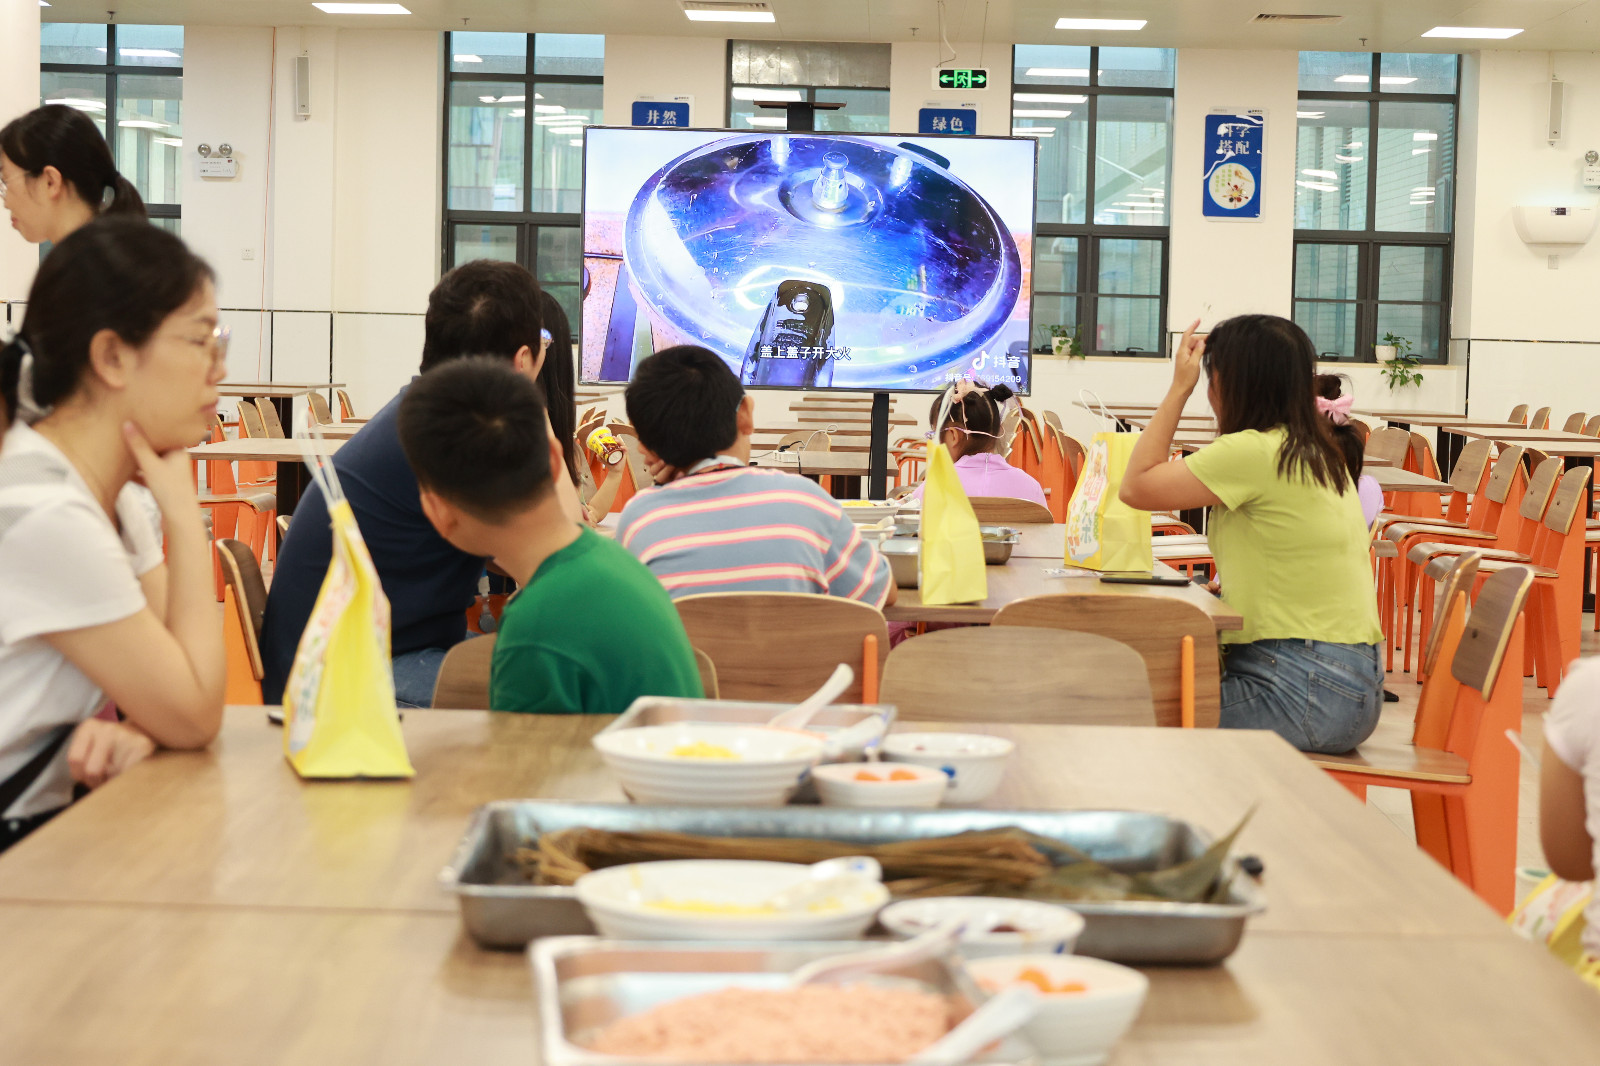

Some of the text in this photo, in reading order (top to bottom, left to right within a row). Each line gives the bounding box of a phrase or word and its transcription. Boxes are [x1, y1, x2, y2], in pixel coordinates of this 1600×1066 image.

[646, 109, 677, 125] 井然
[932, 116, 964, 131] 绿色
[1217, 140, 1250, 155] 搭配
[760, 345, 852, 360] 盖上盖子开大火
[993, 355, 1021, 369] 抖音
[975, 374, 1022, 383] 69154209
